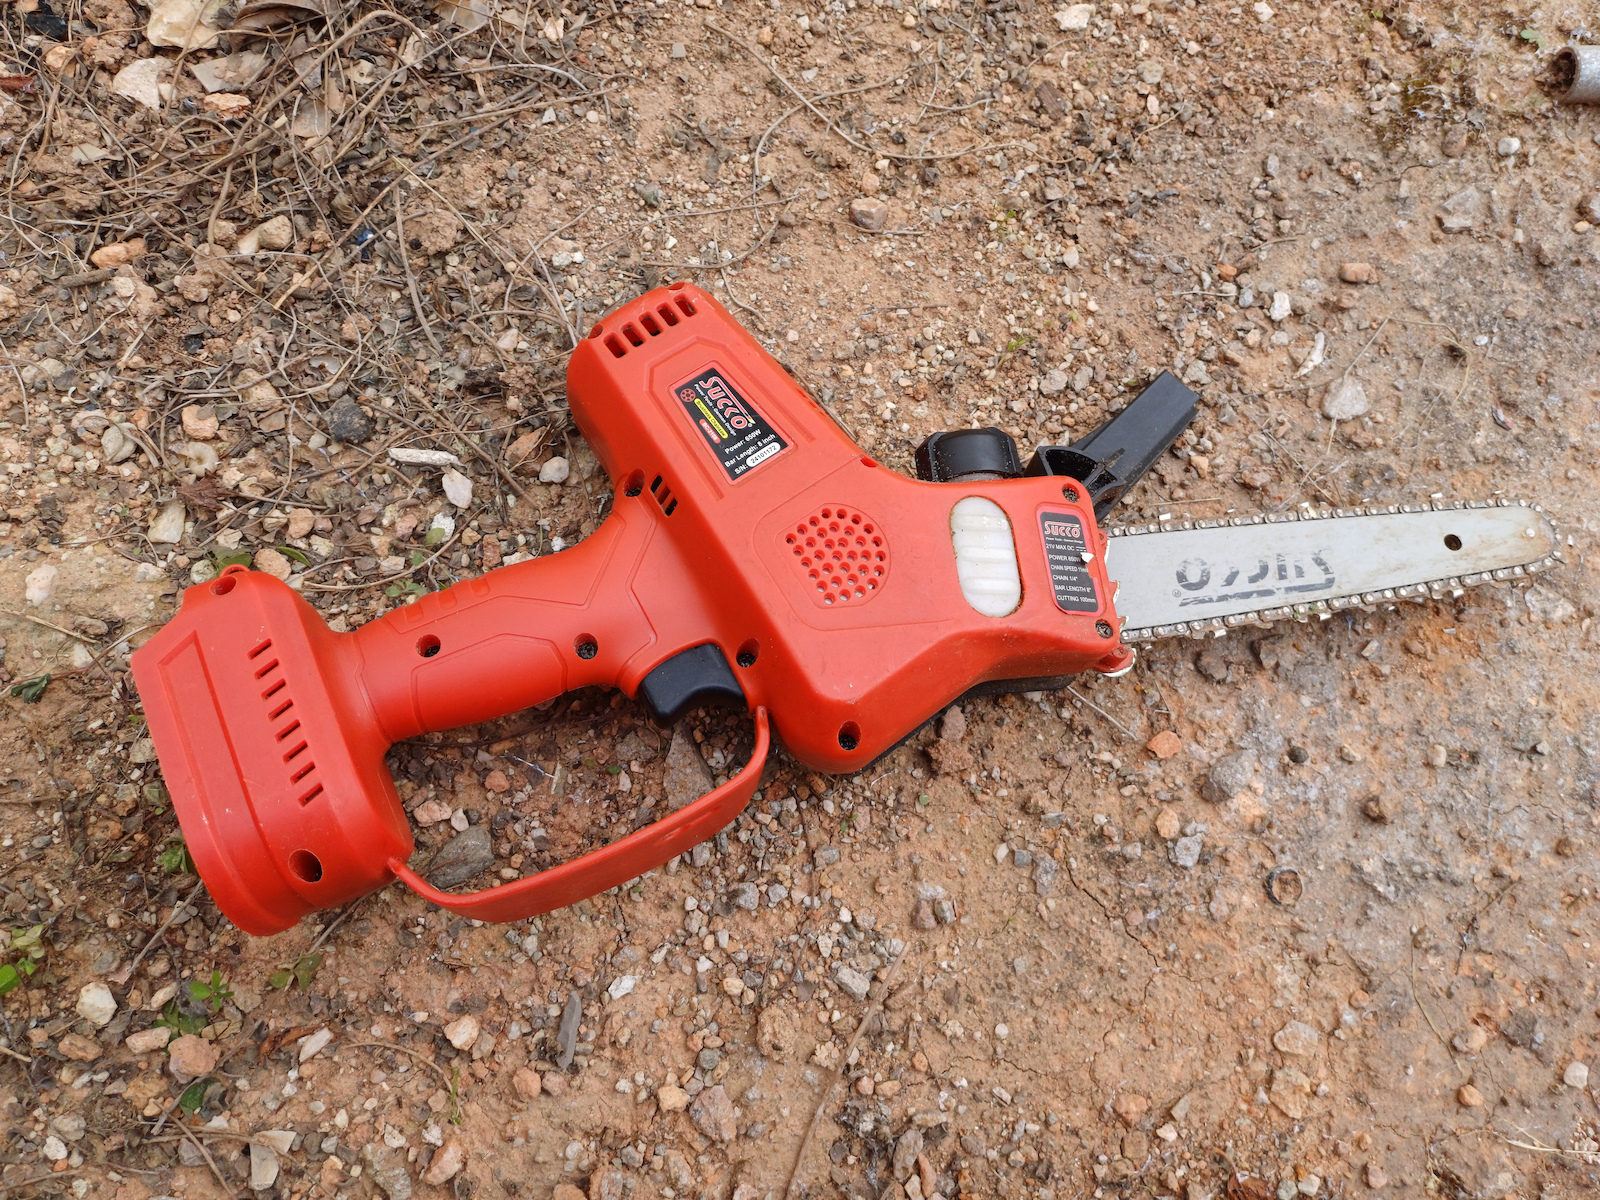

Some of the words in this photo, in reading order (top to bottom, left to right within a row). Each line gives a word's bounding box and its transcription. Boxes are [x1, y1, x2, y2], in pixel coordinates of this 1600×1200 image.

[724, 440, 746, 454] Power:
[744, 429, 761, 442] 650W
[724, 458, 737, 467] Bar
[735, 445, 759, 461] Length:
[761, 434, 776, 445] inch
[734, 464, 748, 474] S/N:
[750, 444, 777, 464] 24101172
[1056, 594, 1079, 602] CUTTING
